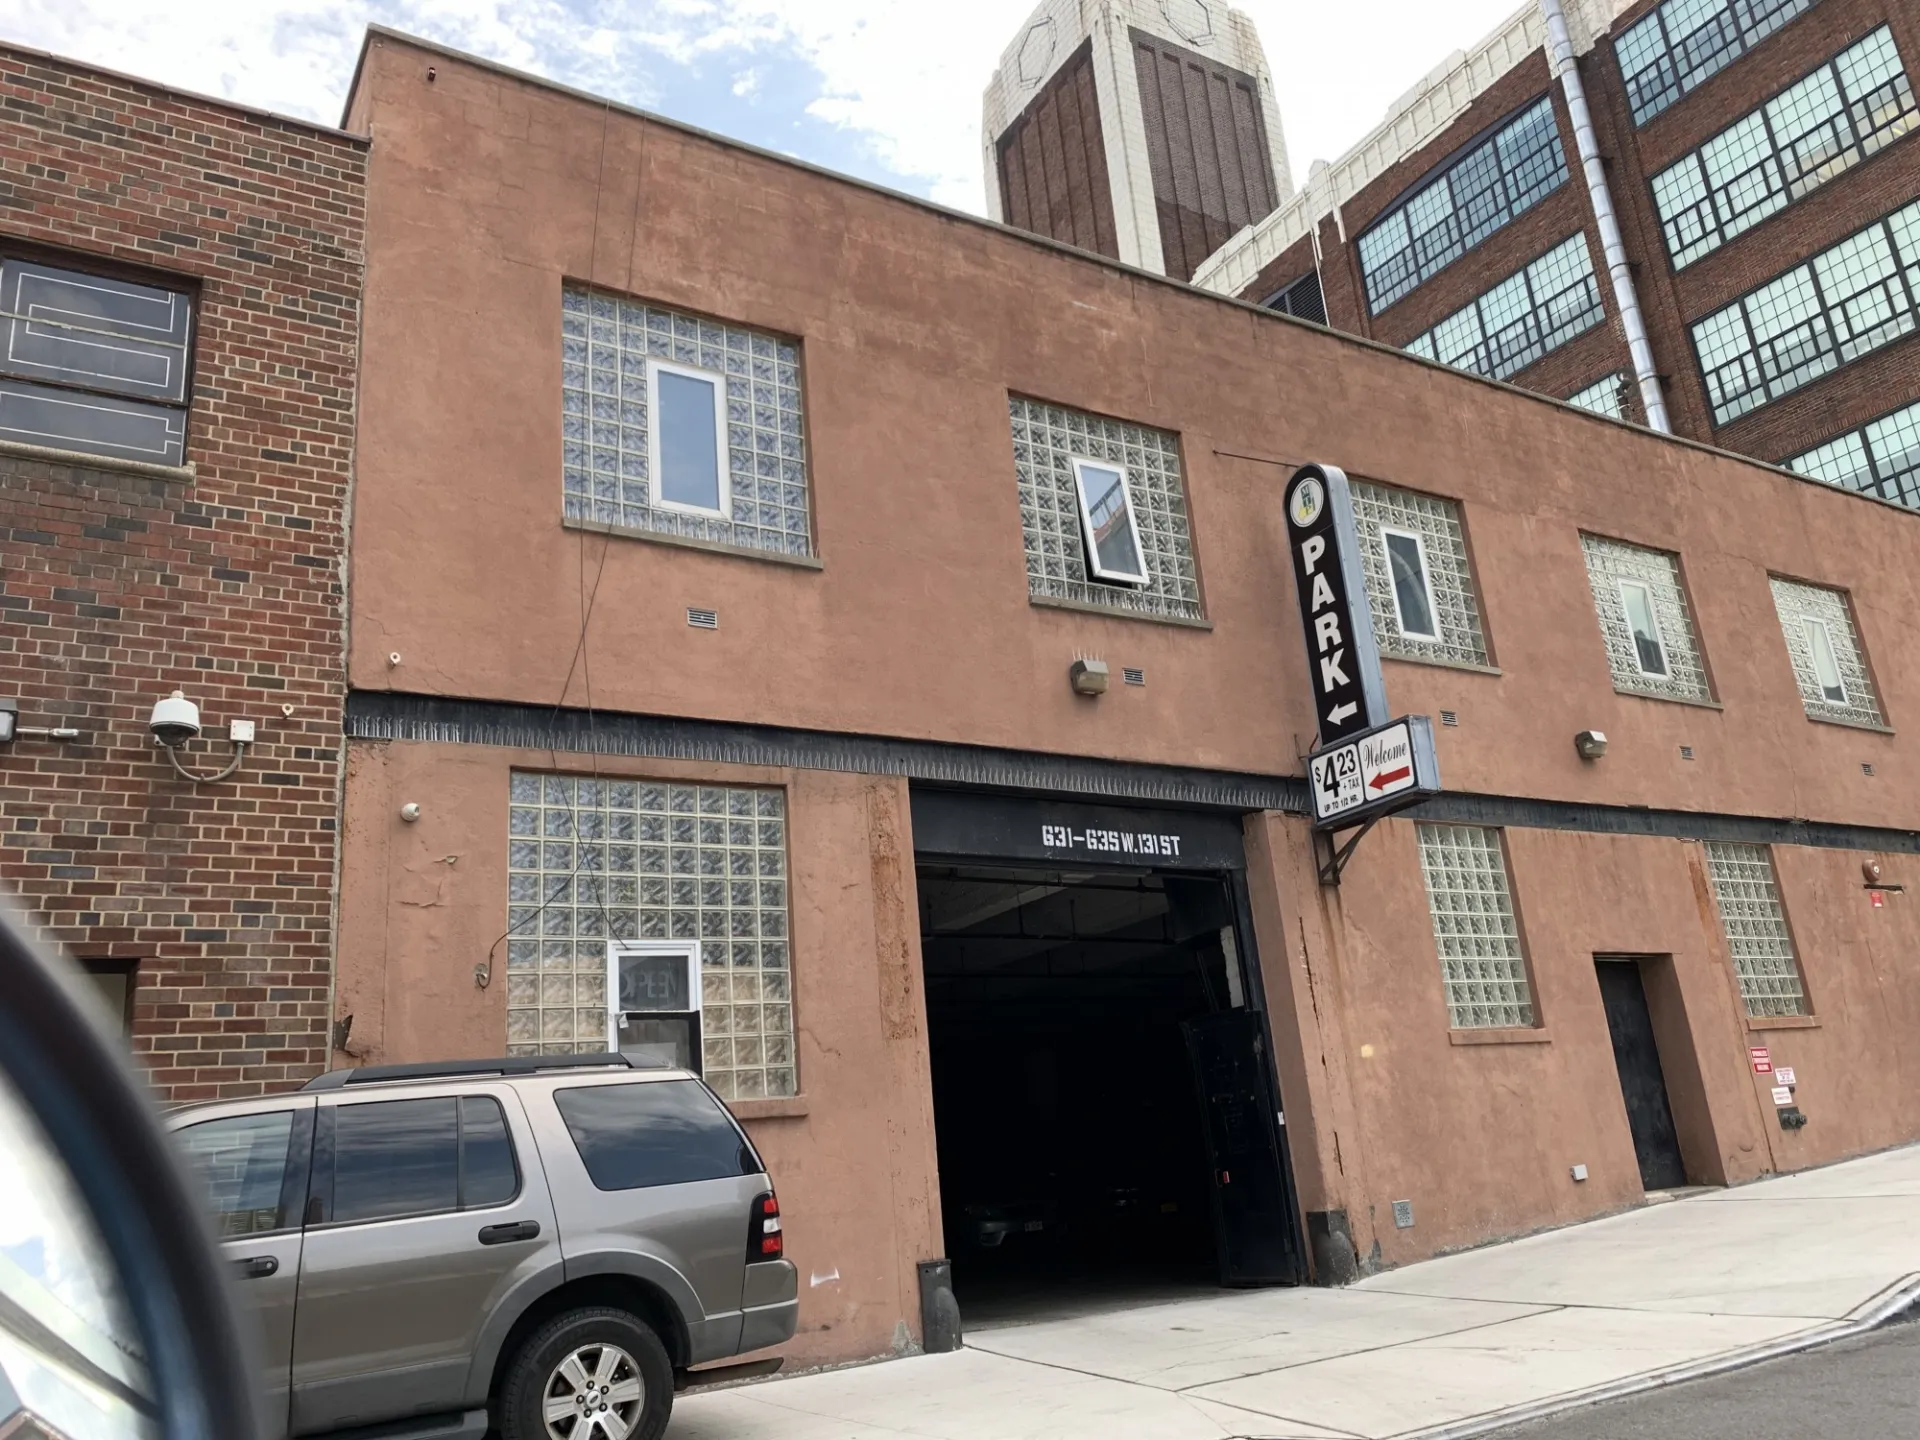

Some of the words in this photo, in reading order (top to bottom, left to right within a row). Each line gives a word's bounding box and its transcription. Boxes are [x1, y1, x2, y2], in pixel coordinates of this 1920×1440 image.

[1301, 534, 1351, 694] PARK
[1363, 739, 1407, 769] Welcome
[1347, 777, 1361, 790] TAX
[1324, 803, 1331, 812] UP
[1332, 801, 1339, 809] TO
[1042, 825, 1120, 852] 631-635
